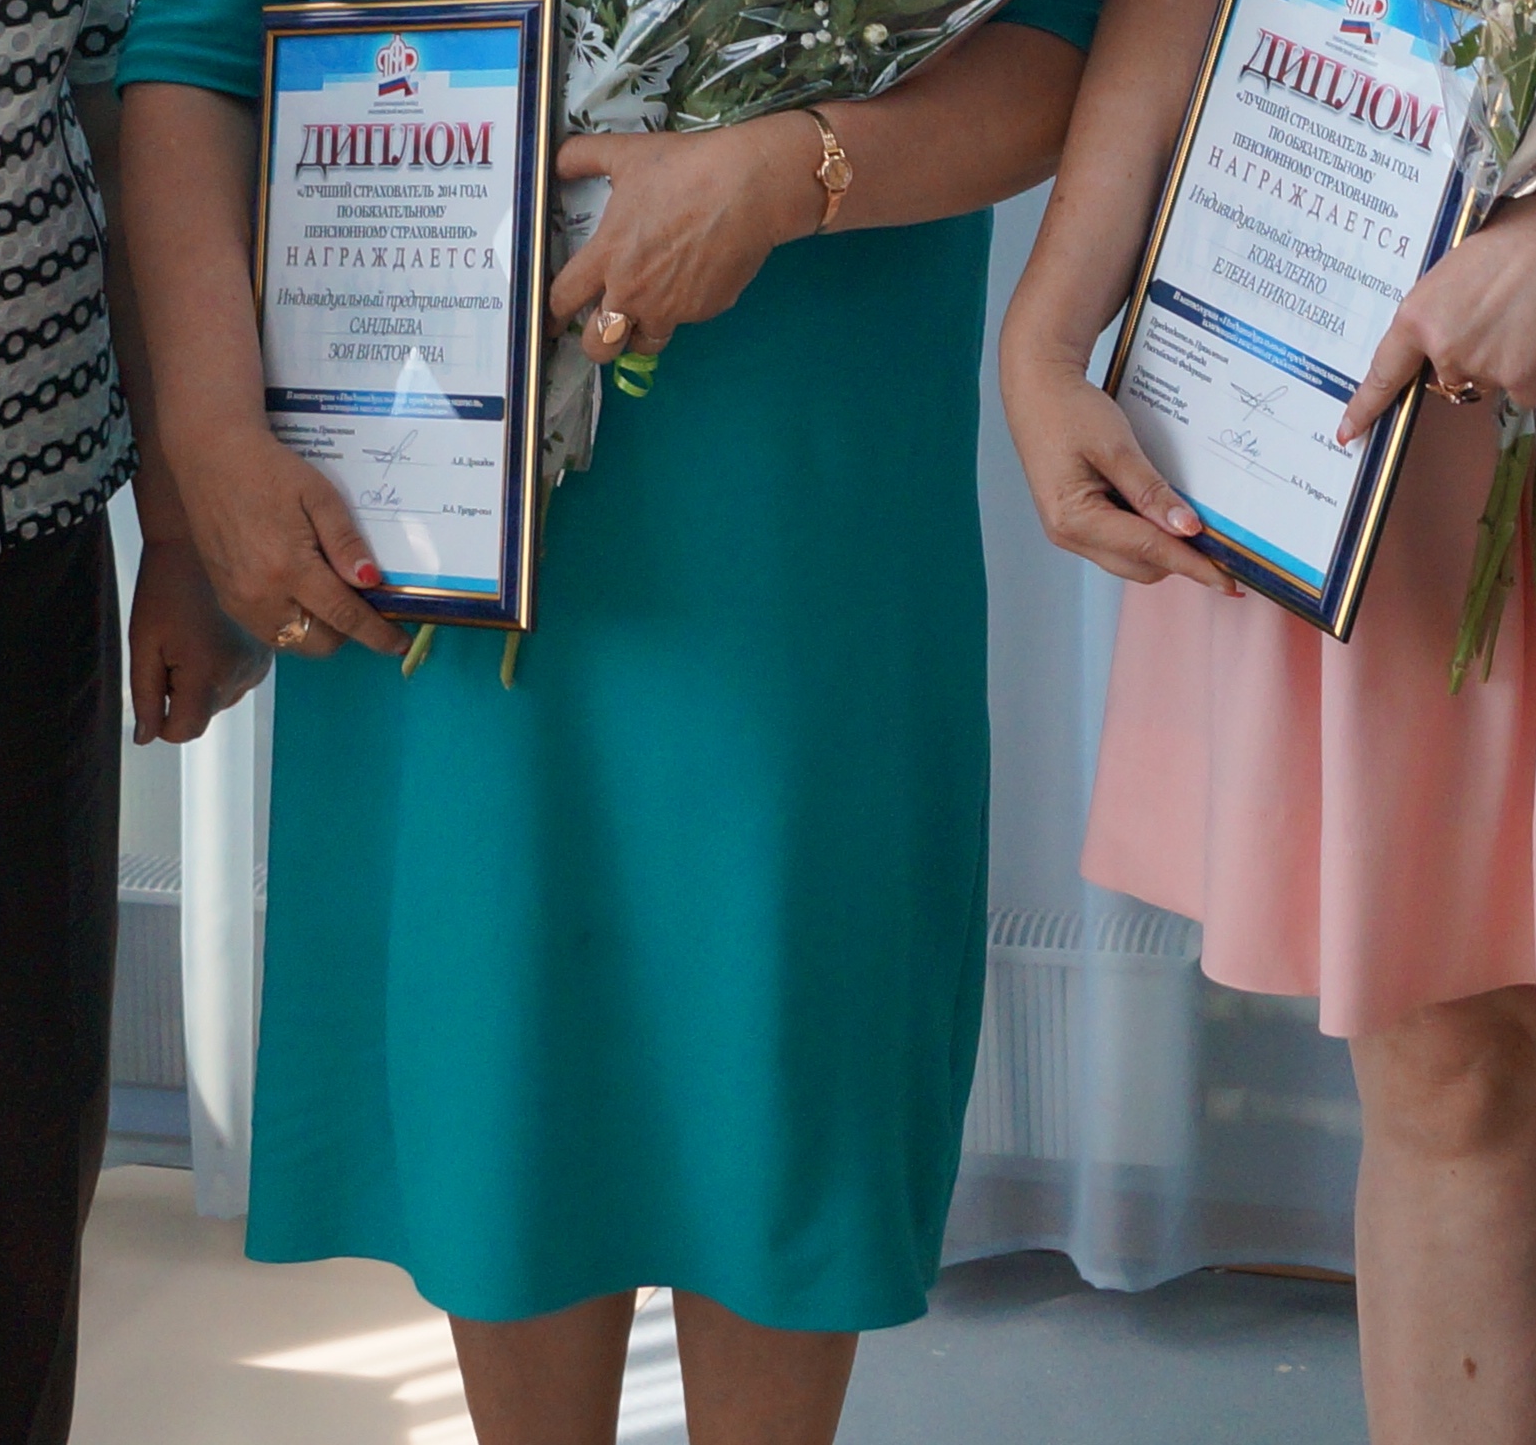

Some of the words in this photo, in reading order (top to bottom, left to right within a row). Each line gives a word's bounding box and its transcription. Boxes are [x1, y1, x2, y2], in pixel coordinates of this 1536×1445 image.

[1240, 28, 1443, 153] ДИПЛОМ
[295, 120, 493, 178] ДИПЛОМ
[1234, 86, 1290, 123] «ЛУЧШИЙ
[1288, 112, 1368, 158] СТРАХОВАТЕЛЬ
[1369, 149, 1391, 169] 2014
[1390, 158, 1421, 183] ГОДА
[1267, 125, 1286, 144] ПО
[1284, 133, 1375, 185] ОБЯЗАТЕЛЬНОМУ
[297, 183, 351, 197] «ЛУЧШИЙ
[353, 184, 434, 197] СТРАХОВАТЕЛЬ
[437, 184, 456, 197] 2014
[459, 184, 487, 198] ГОДА
[1207, 148, 1410, 258] НАГРАЖДАЕТСЯ
[1232, 132, 1314, 180] ПЕНСИОННОМУ
[1313, 170, 1399, 220] СТРАХОВАНИЮ»
[303, 225, 389, 239] ПЕНСИОННОМУ
[390, 225, 477, 239] СТРАХОВАНИЮ»
[336, 205, 353, 217] ПО
[354, 204, 446, 218] ОБЯЗАТЕЛЬНОМУ
[285, 245, 494, 272] НАГРАЖДАЕТСЯ
[1186, 184, 1293, 252] Индивидуальный
[1289, 234, 1406, 306] предприниматель
[1247, 244, 1328, 295] КОВАЛЕНКО
[276, 287, 384, 311] Индивидуальный
[385, 289, 503, 314] предприниматель
[1211, 256, 1259, 292] ЕЛЕНА
[1255, 278, 1347, 335] НИКОЛАЕВНА
[327, 342, 356, 359] ЗОЯ
[349, 317, 422, 335] САНДЫЕВА
